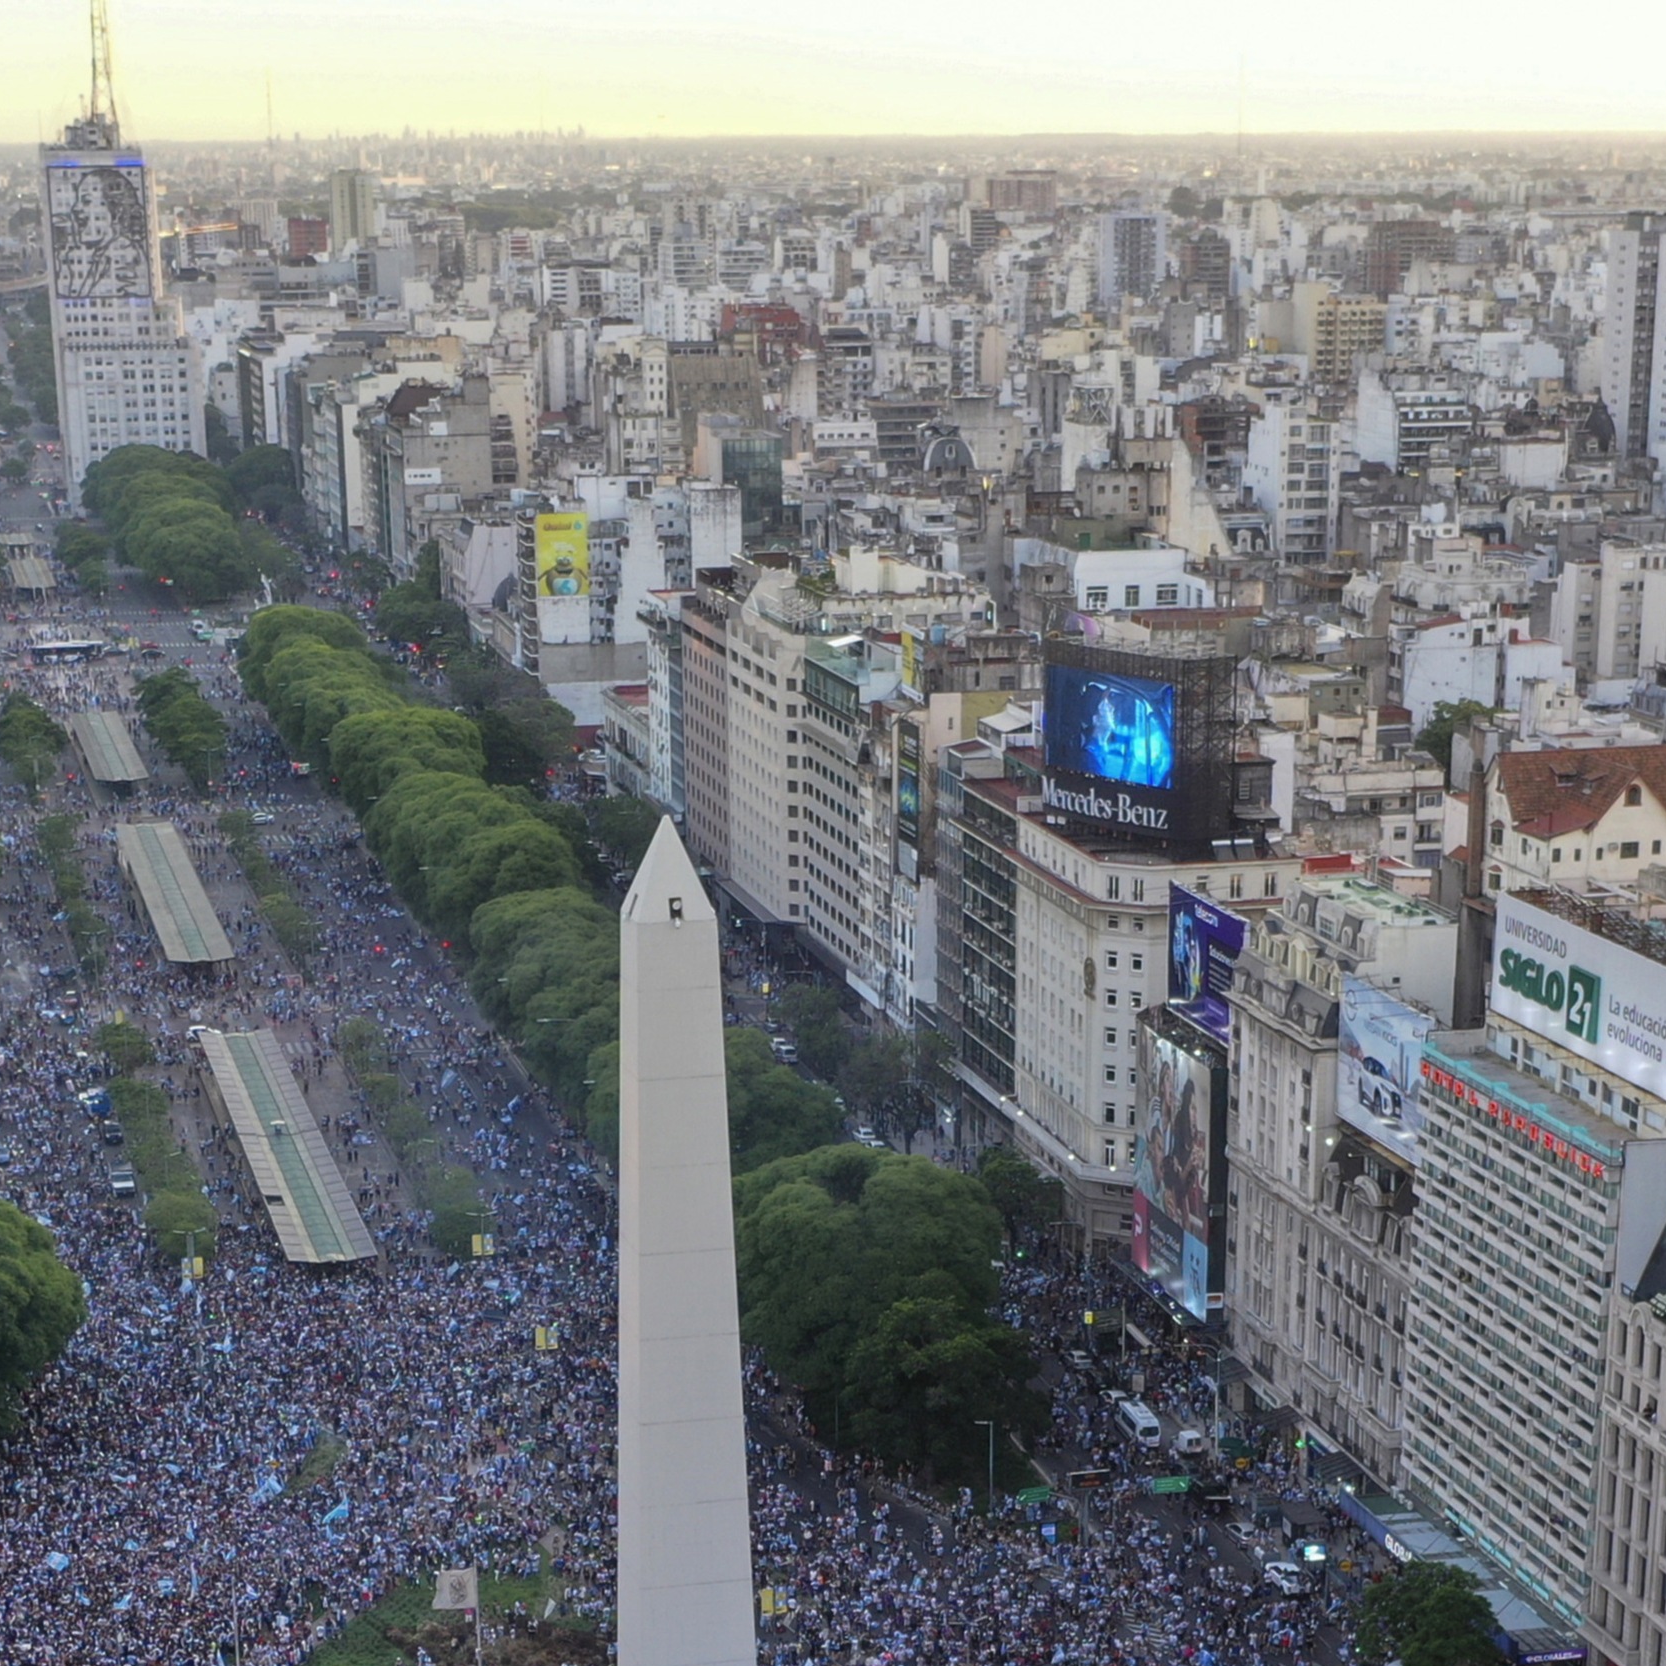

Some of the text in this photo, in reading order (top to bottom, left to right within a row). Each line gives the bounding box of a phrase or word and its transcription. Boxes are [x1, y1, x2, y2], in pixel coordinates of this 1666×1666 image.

[1041, 775, 1168, 830] Mercedes-Benz
[1505, 915, 1567, 958] UNIVERSIDAD
[1499, 947, 1592, 1041] SIGLO 21
[1608, 994, 1620, 1015] La
[1607, 1022, 1663, 1063] evoluciona
[1420, 1060, 1479, 1106] HOTEL
